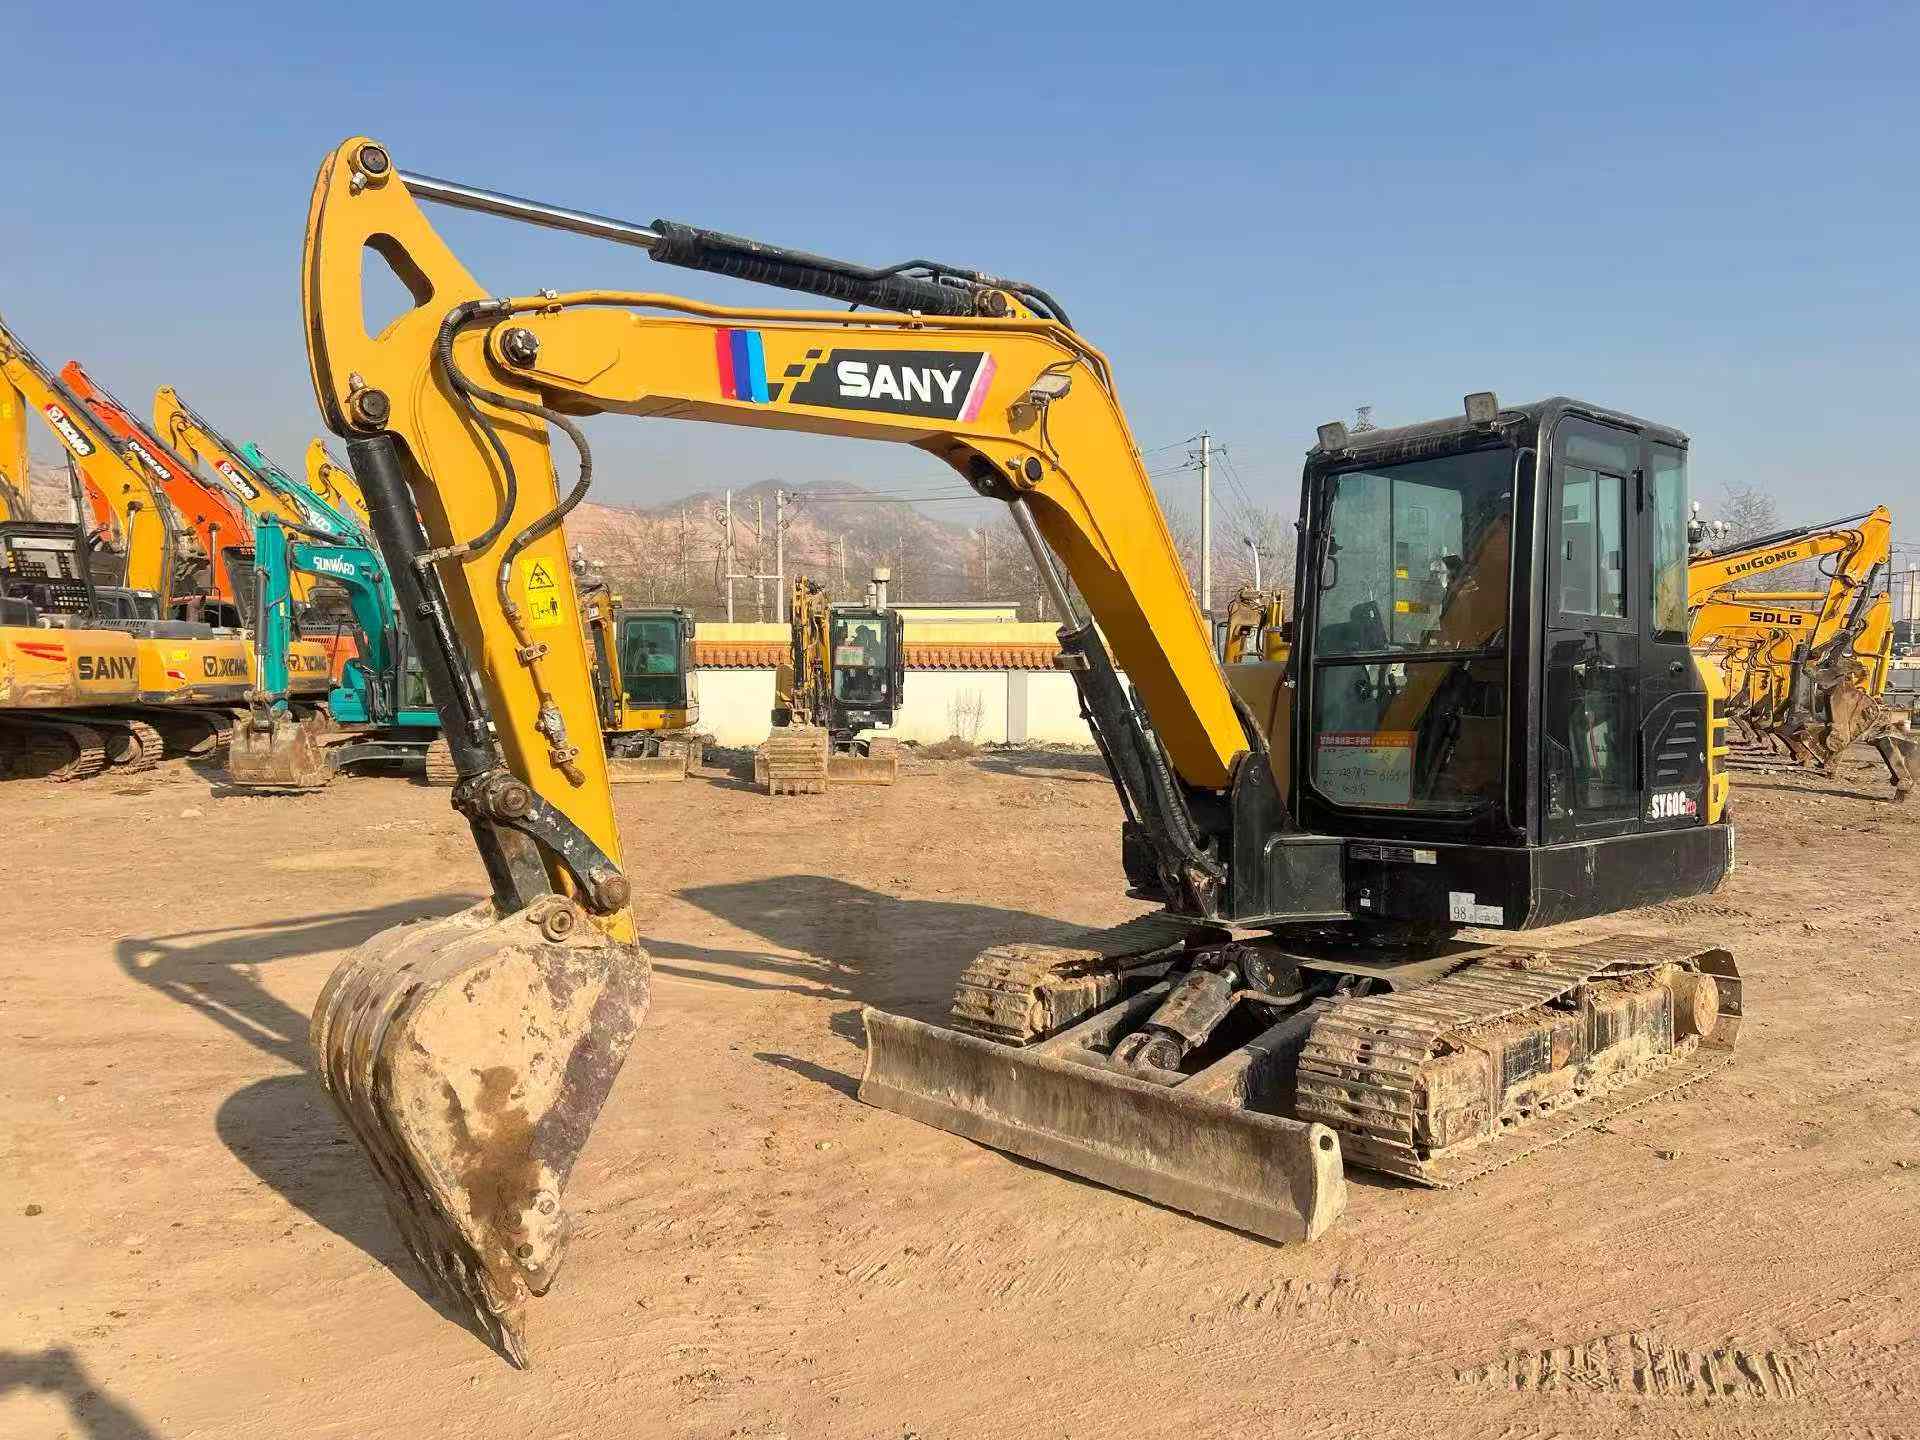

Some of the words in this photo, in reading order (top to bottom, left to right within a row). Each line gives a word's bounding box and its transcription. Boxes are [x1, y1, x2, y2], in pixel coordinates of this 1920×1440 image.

[837, 360, 961, 404] SANY
[313, 555, 355, 575] SUNWARD
[1749, 611, 1803, 625] SDLG
[78, 656, 137, 680] SANY
[1651, 791, 1686, 819] SY60C
[1453, 906, 1467, 920] 98
